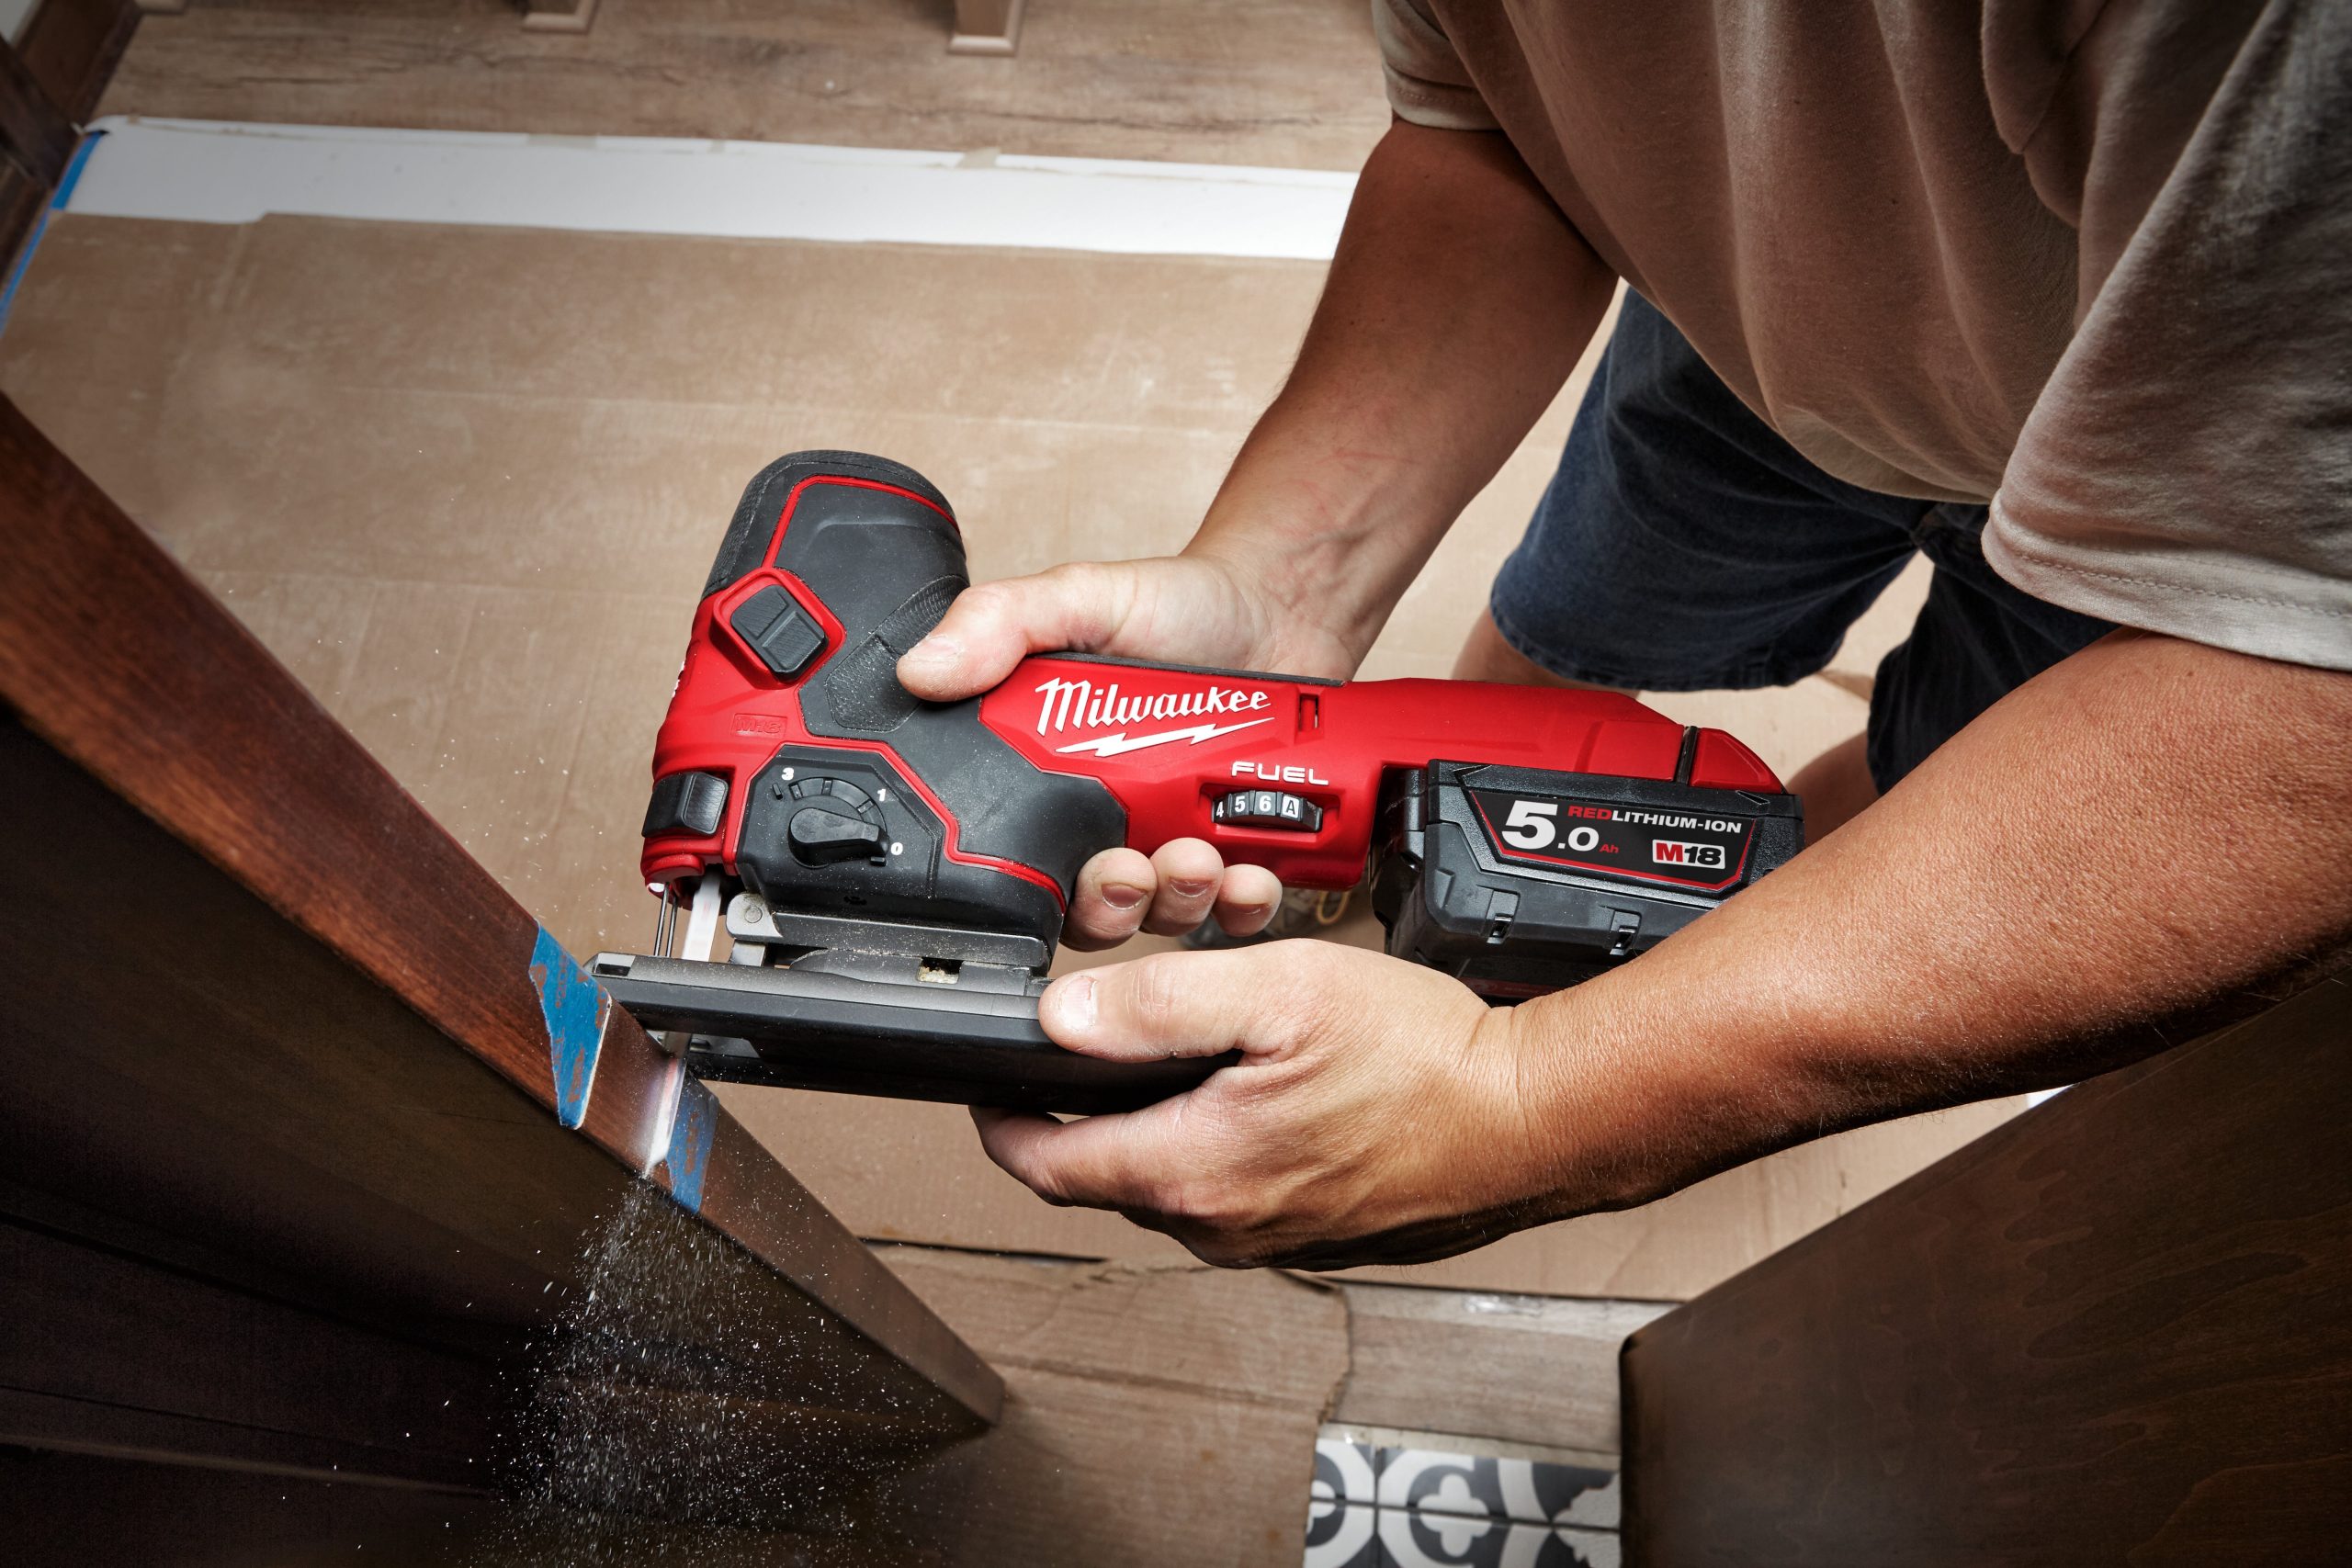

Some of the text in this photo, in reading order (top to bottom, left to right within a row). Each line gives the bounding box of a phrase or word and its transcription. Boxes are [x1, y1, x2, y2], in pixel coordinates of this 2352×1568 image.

[1035, 677, 1272, 736] Milwaukee
[737, 718, 782, 734] M18
[781, 767, 795, 781] 3
[1231, 761, 1329, 785] FUEL
[876, 788, 887, 801] 1
[1216, 795, 1296, 818] 4 5 6 A
[1567, 805, 1743, 834] REDLITHIUM-ION
[1599, 843, 1620, 854] Ah
[1656, 841, 1723, 866] M18
